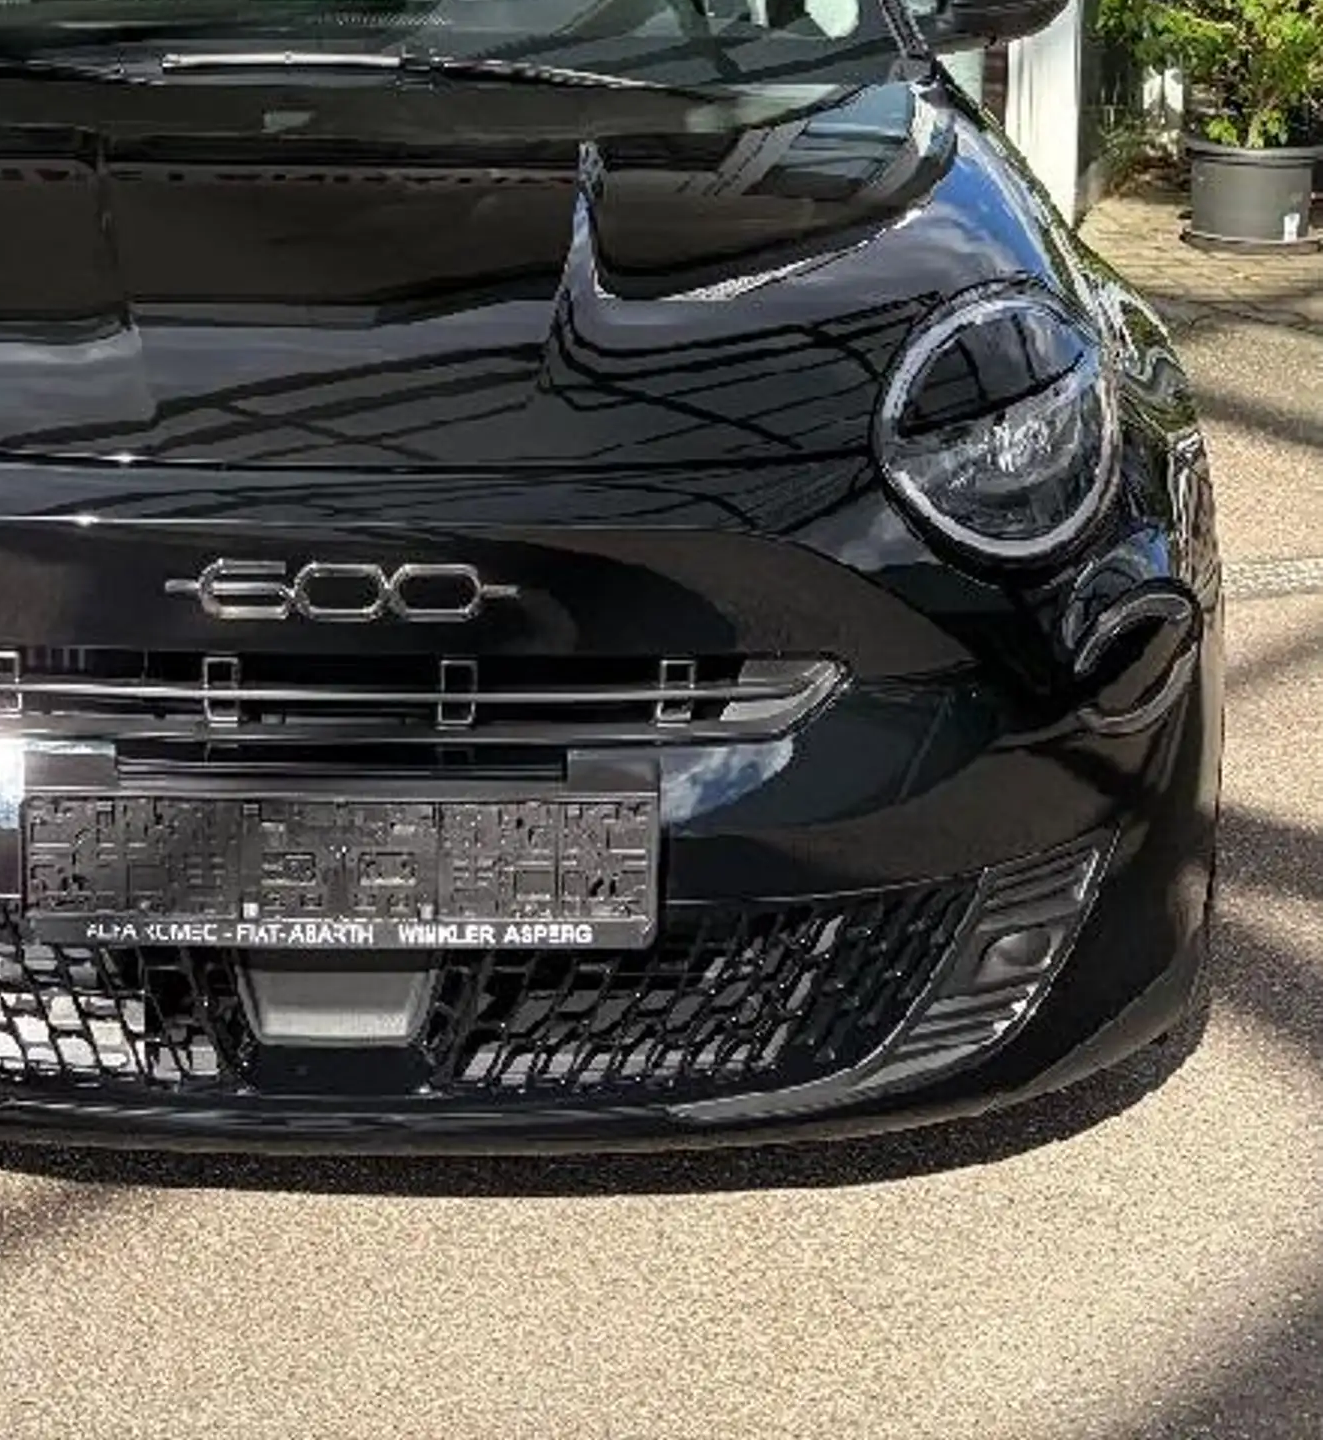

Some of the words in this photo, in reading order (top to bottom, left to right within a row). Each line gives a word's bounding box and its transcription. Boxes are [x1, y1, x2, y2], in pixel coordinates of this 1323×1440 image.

[195, 556, 484, 623] 600
[398, 923, 497, 945] WINKLER
[503, 923, 594, 945] ASPERG
